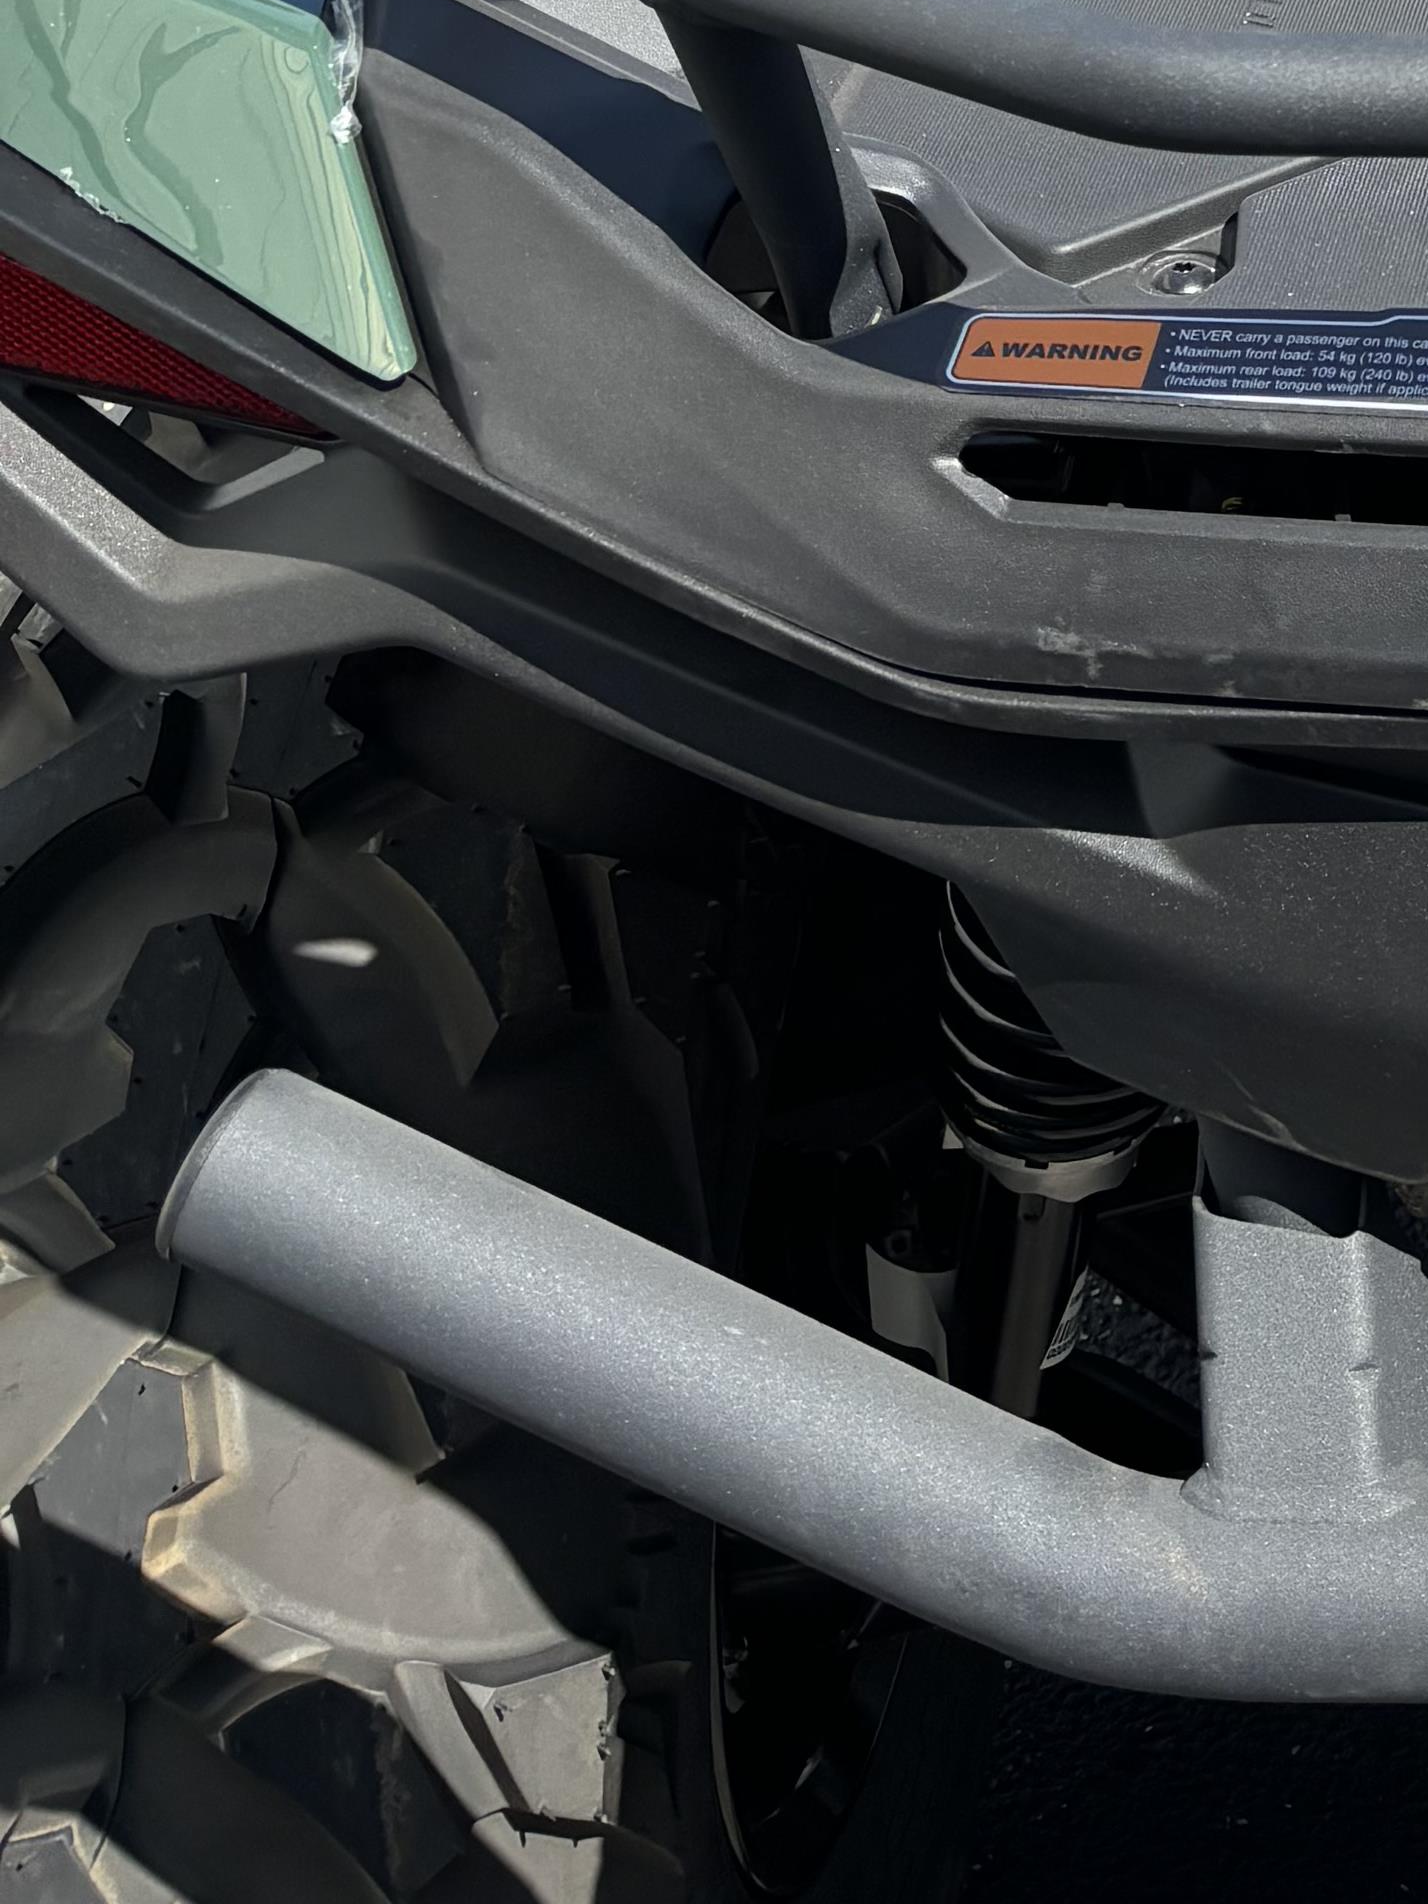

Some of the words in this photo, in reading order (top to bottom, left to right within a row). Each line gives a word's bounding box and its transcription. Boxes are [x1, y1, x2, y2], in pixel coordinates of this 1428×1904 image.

[1178, 328, 1232, 343] NEVER
[1236, 333, 1271, 346] carry
[1274, 334, 1283, 344] a
[1286, 334, 1360, 349] passenger
[1363, 337, 1380, 348] on
[1385, 336, 1409, 349] this
[1001, 341, 1144, 363] WARNING
[1174, 345, 1241, 360] Maximum
[1245, 347, 1276, 361] front
[1280, 350, 1314, 362] load:
[1317, 350, 1335, 362] 54
[1339, 351, 1356, 366] kg
[1359, 352, 1391, 366] (120
[1395, 353, 1413, 367] lb)
[1168, 362, 1236, 375] Maximum
[1239, 366, 1269, 376] rear
[1272, 366, 1306, 377] load:
[1312, 366, 1337, 378] 109
[1339, 367, 1357, 382] kg
[1360, 367, 1392, 382] (240
[1395, 370, 1414, 384] lb)
[1164, 374, 1227, 388] (Includes
[1232, 376, 1271, 390] trailer
[1275, 379, 1322, 394] tongue
[1326, 381, 1372, 396] weight
[1376, 383, 1385, 394] if
